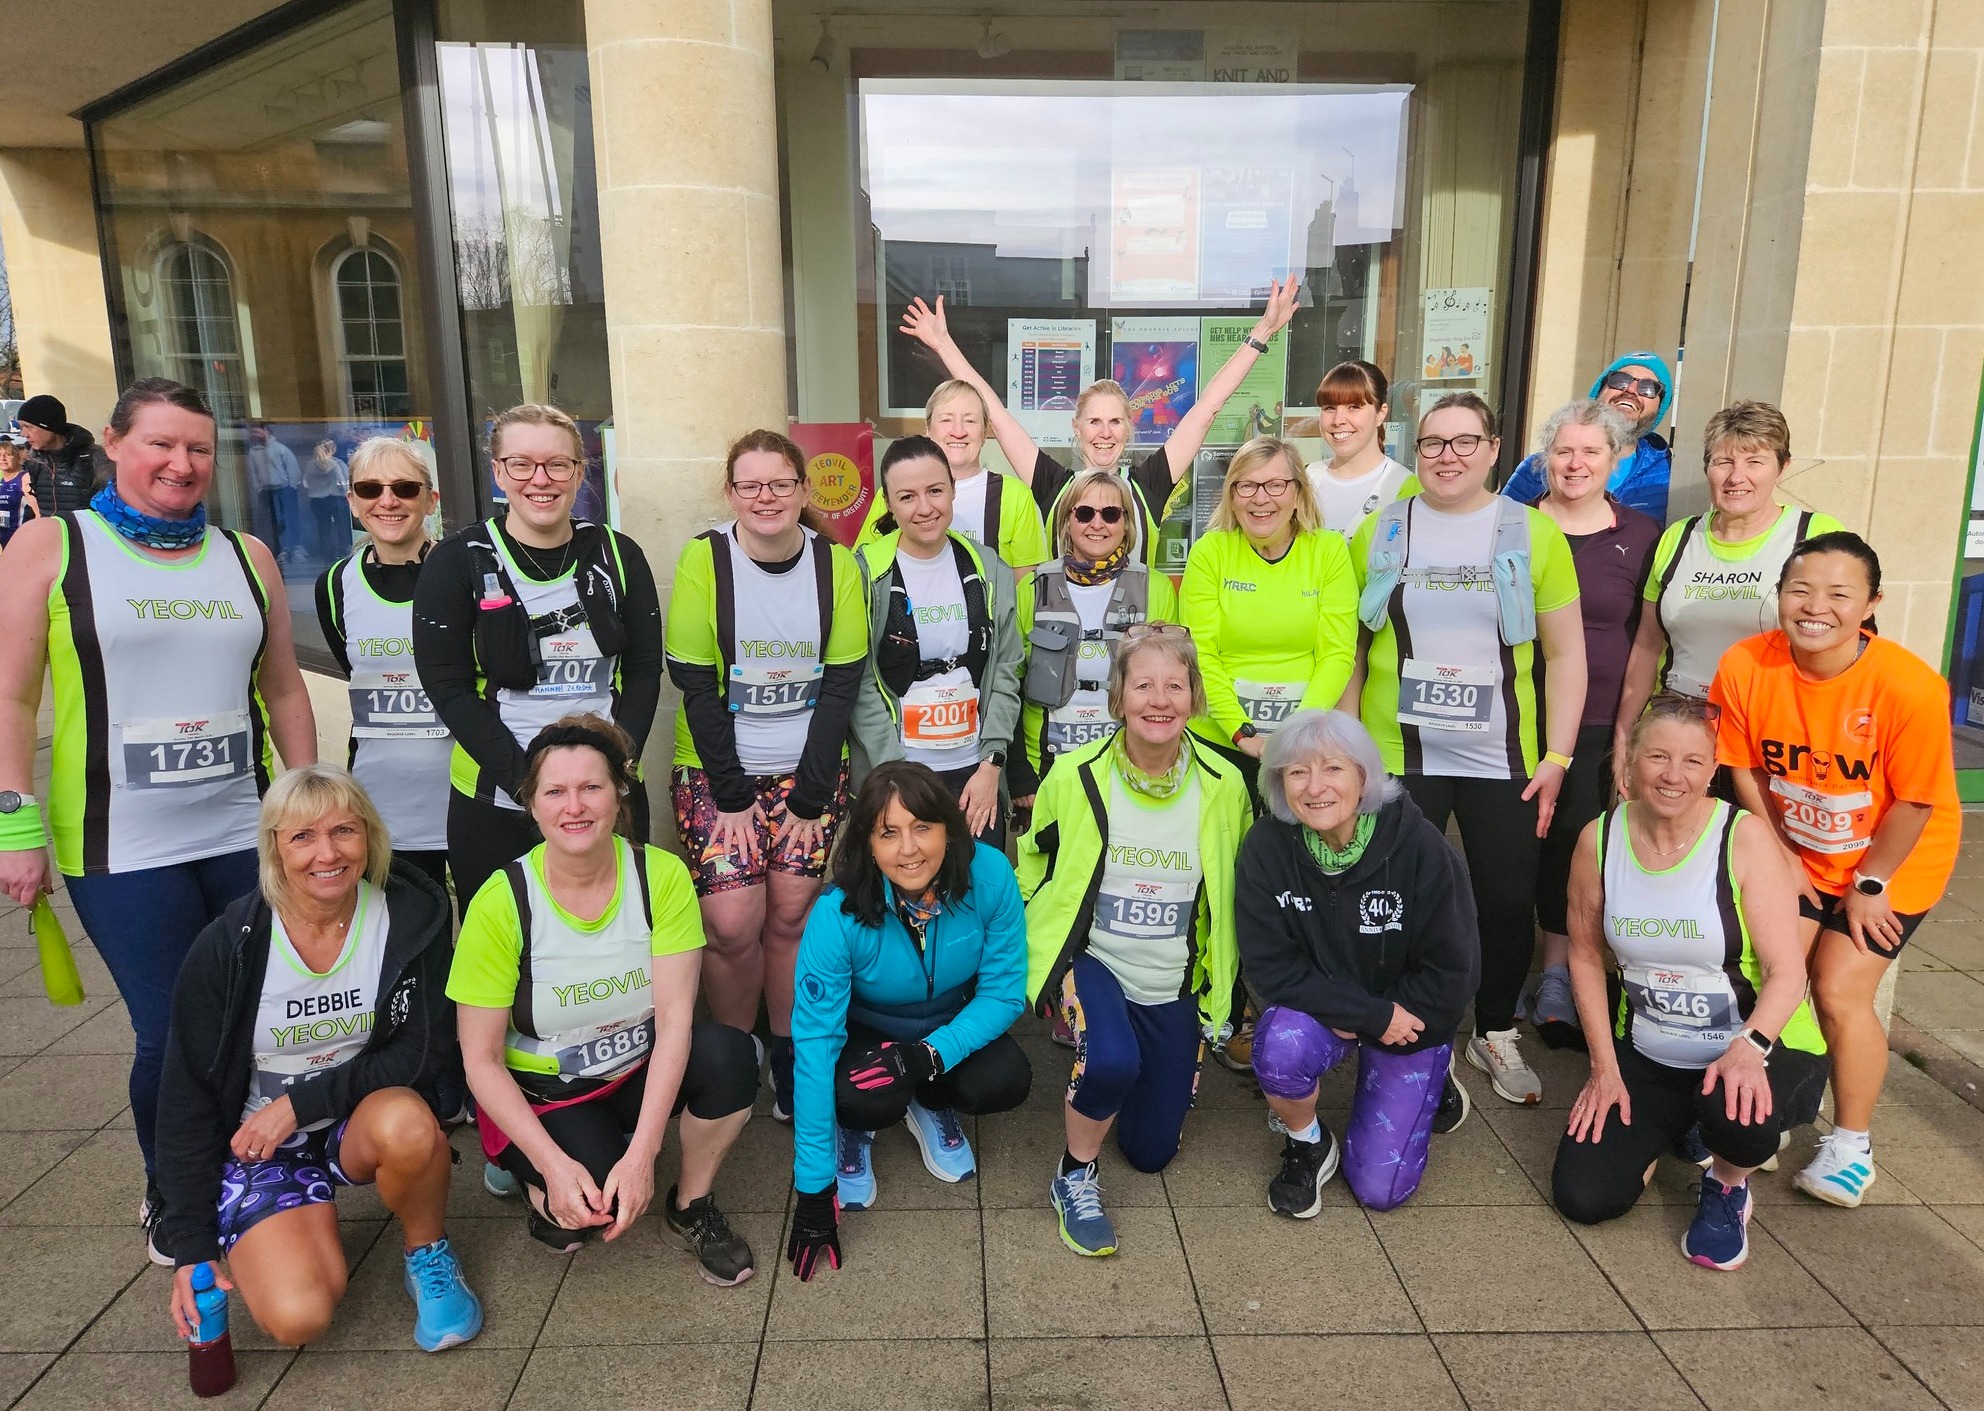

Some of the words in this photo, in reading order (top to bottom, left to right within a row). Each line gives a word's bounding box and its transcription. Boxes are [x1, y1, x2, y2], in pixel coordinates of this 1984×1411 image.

[1213, 69, 1248, 82] KNIT
[1255, 69, 1290, 82] AND
[1209, 334, 1225, 342] NHS
[1226, 334, 1245, 342] HEAR
[814, 458, 847, 471] YEOVIL
[819, 475, 845, 488] ART
[831, 512, 841, 520] OF
[1691, 571, 1762, 584] SHARON
[1684, 585, 1763, 601] YEOVIL
[127, 599, 243, 620] YEOVIL
[358, 637, 415, 657] YEOV
[740, 640, 818, 659] YEOVIL
[546, 660, 598, 685] 707
[368, 690, 435, 713] 1703
[746, 681, 810, 705] 1517
[1416, 681, 1478, 707] 1530
[918, 703, 968, 726] 2001
[426, 728, 446, 736] 1703
[1061, 722, 1117, 744] 1556
[1464, 722, 1482, 730] 1530
[964, 735, 975, 744] 2001
[150, 737, 232, 770] 1731
[1783, 799, 1851, 831] 2099
[1841, 840, 1864, 850] 2099
[1107, 843, 1193, 871] YEOVIL
[1113, 898, 1179, 926] 1596
[1611, 915, 1705, 940] YEOVIL
[553, 966, 651, 1008] YEOVIL
[286, 988, 363, 1020] DEBBIE
[1640, 988, 1711, 1018] 1546
[578, 1024, 649, 1067] 1686
[1701, 1031, 1725, 1041] 1546
